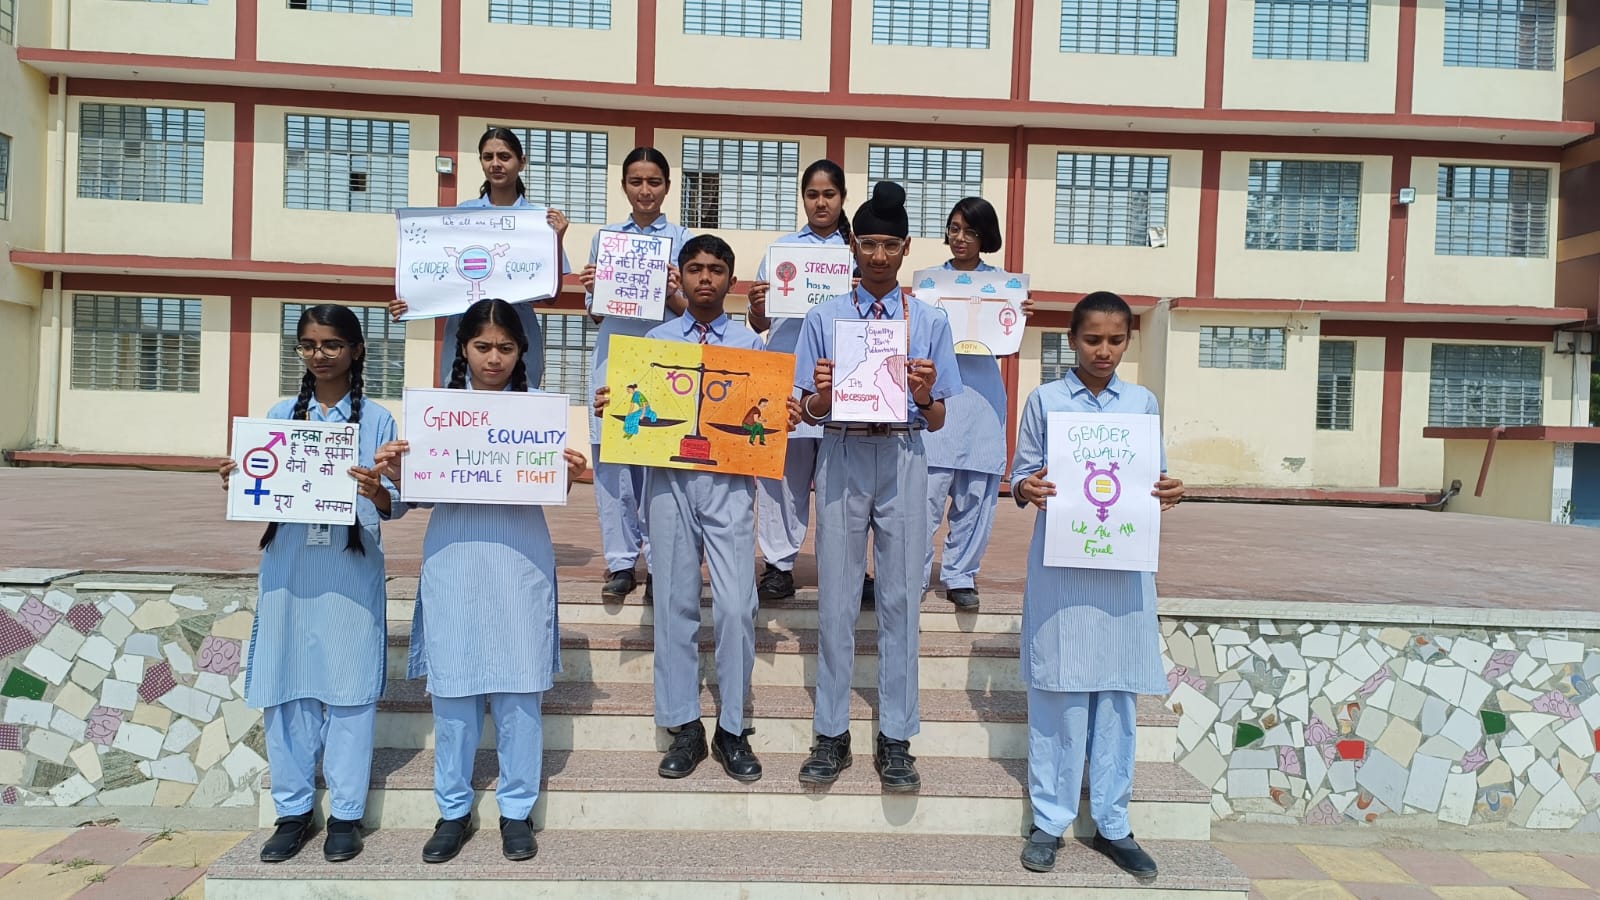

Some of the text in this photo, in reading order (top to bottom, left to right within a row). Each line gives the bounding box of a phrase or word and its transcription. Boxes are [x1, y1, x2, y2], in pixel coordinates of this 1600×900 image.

[442, 215, 454, 226] We
[459, 217, 471, 226] all
[602, 232, 628, 253] स्त्री
[411, 260, 542, 275] GENDER EQUALITY
[596, 265, 614, 281] स्त्री
[615, 271, 628, 284] हर
[804, 262, 849, 275] STRENGTH
[806, 277, 821, 289] has
[868, 326, 894, 340] Equality
[834, 389, 880, 412] Necessary
[424, 406, 491, 431] GENDER
[290, 426, 355, 446] लड़का लड़की
[487, 428, 566, 445] EQUALITY
[1067, 424, 1131, 448] GENDER
[290, 442, 299, 456] है
[324, 446, 354, 460] समान
[429, 448, 558, 466] IS A HUMAN FIGHT
[1072, 446, 1136, 465] EQUALITY
[319, 460, 335, 476] को
[414, 469, 557, 484] NOT A FEMALE FIGHT
[301, 480, 312, 493] दो
[273, 494, 295, 513] पूरा
[314, 499, 353, 514] सम्मान
[1071, 519, 1088, 535] We
[1119, 522, 1136, 537] All
[1083, 539, 1114, 557] Equal
